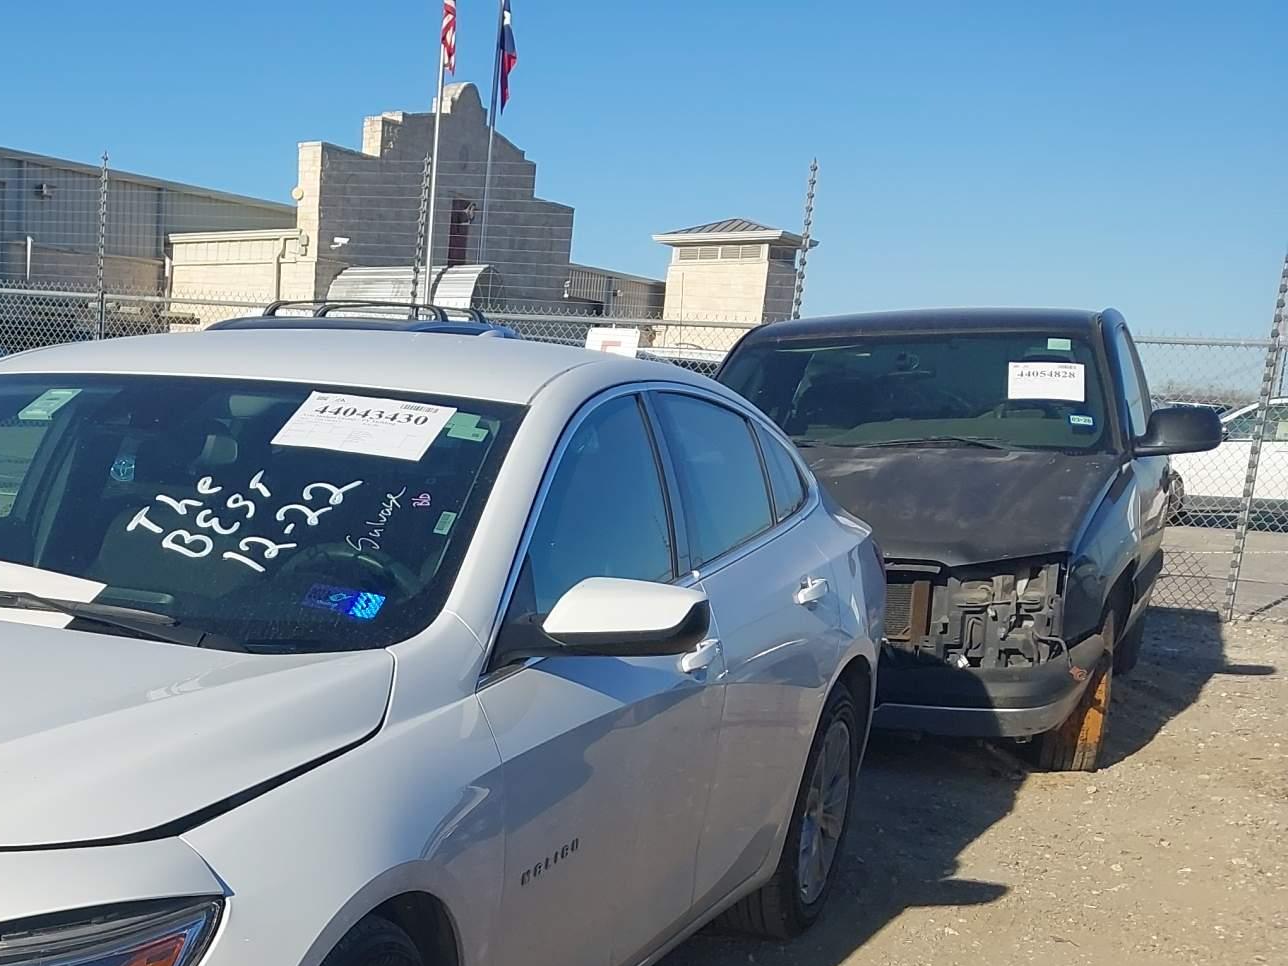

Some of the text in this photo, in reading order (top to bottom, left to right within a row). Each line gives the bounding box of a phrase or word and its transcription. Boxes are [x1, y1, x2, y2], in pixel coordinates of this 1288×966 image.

[1017, 369, 1076, 379] 44054828
[314, 404, 429, 427] 44043430
[126, 476, 222, 534] The
[222, 479, 363, 572] 12-22
